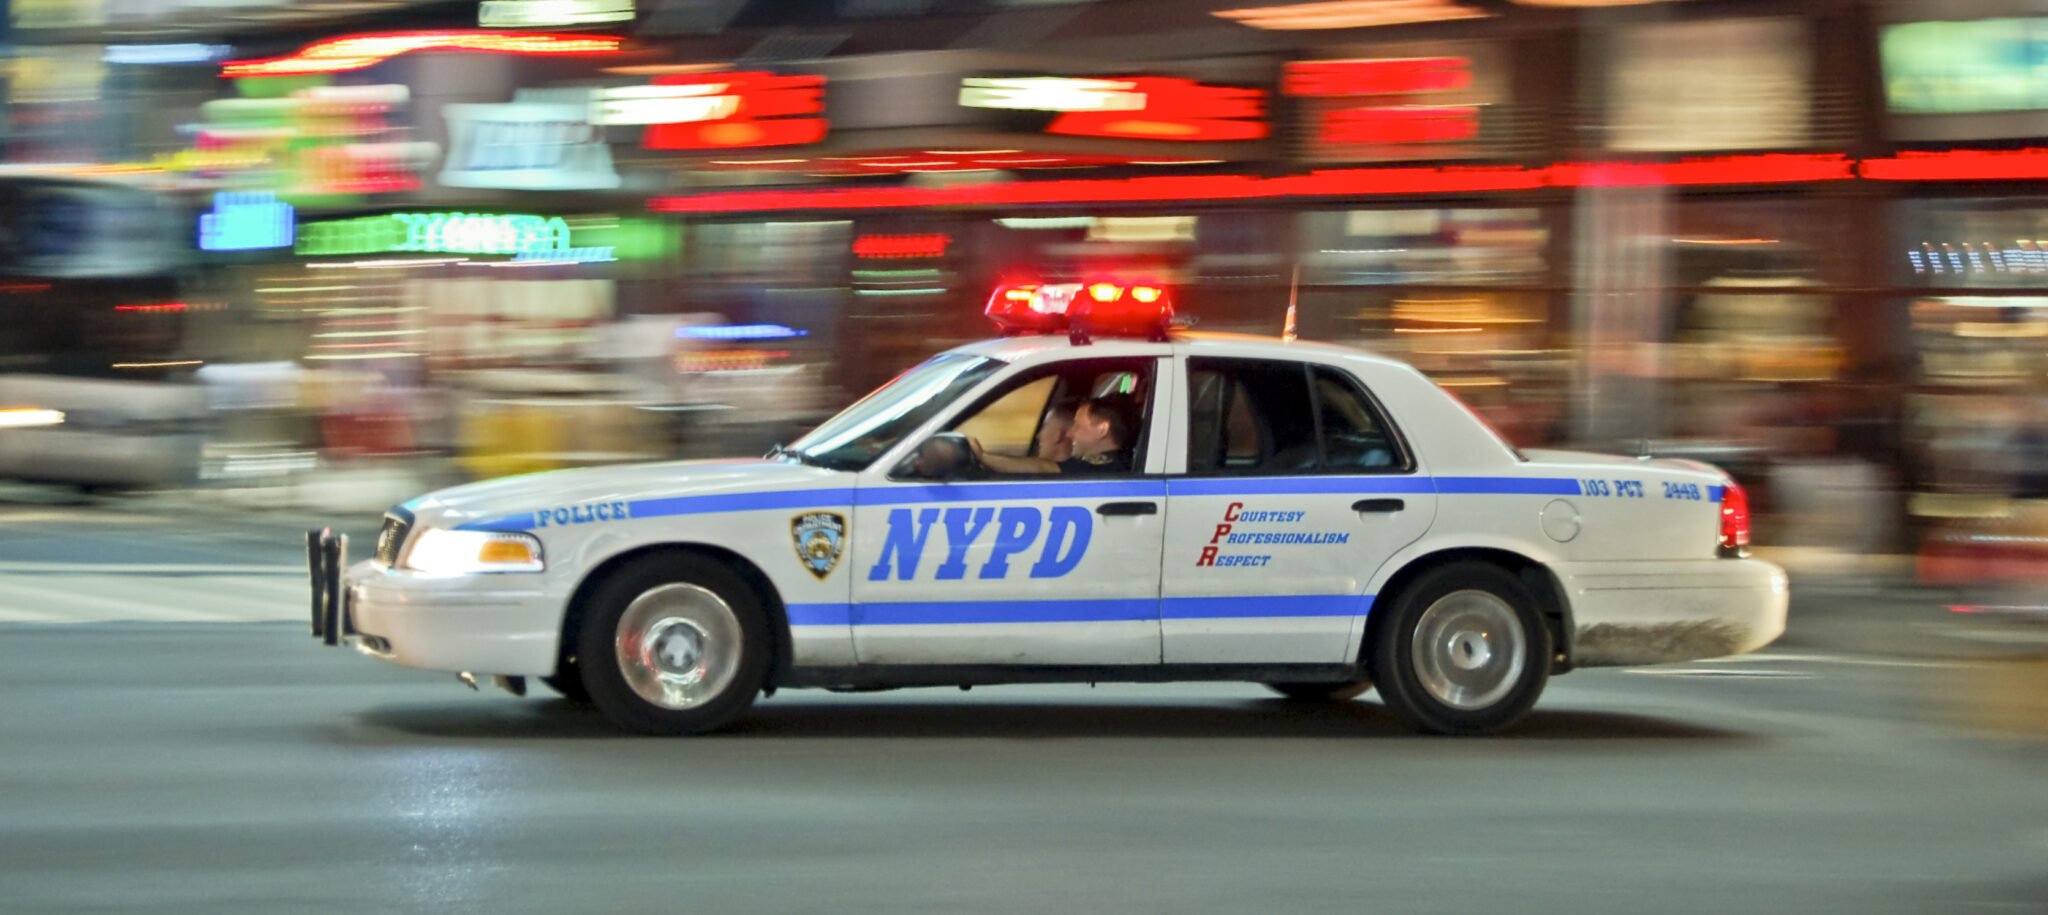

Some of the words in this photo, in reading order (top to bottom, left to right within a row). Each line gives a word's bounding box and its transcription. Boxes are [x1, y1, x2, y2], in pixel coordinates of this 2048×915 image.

[1582, 479, 1610, 497] 103
[1613, 480, 1645, 498] PCT
[537, 502, 629, 528] POLICE
[1224, 502, 1306, 522] COURTESY
[868, 506, 1094, 581] NYPD
[1210, 524, 1350, 544] PROFESSIONALISM
[1196, 546, 1272, 567] RESPECT
